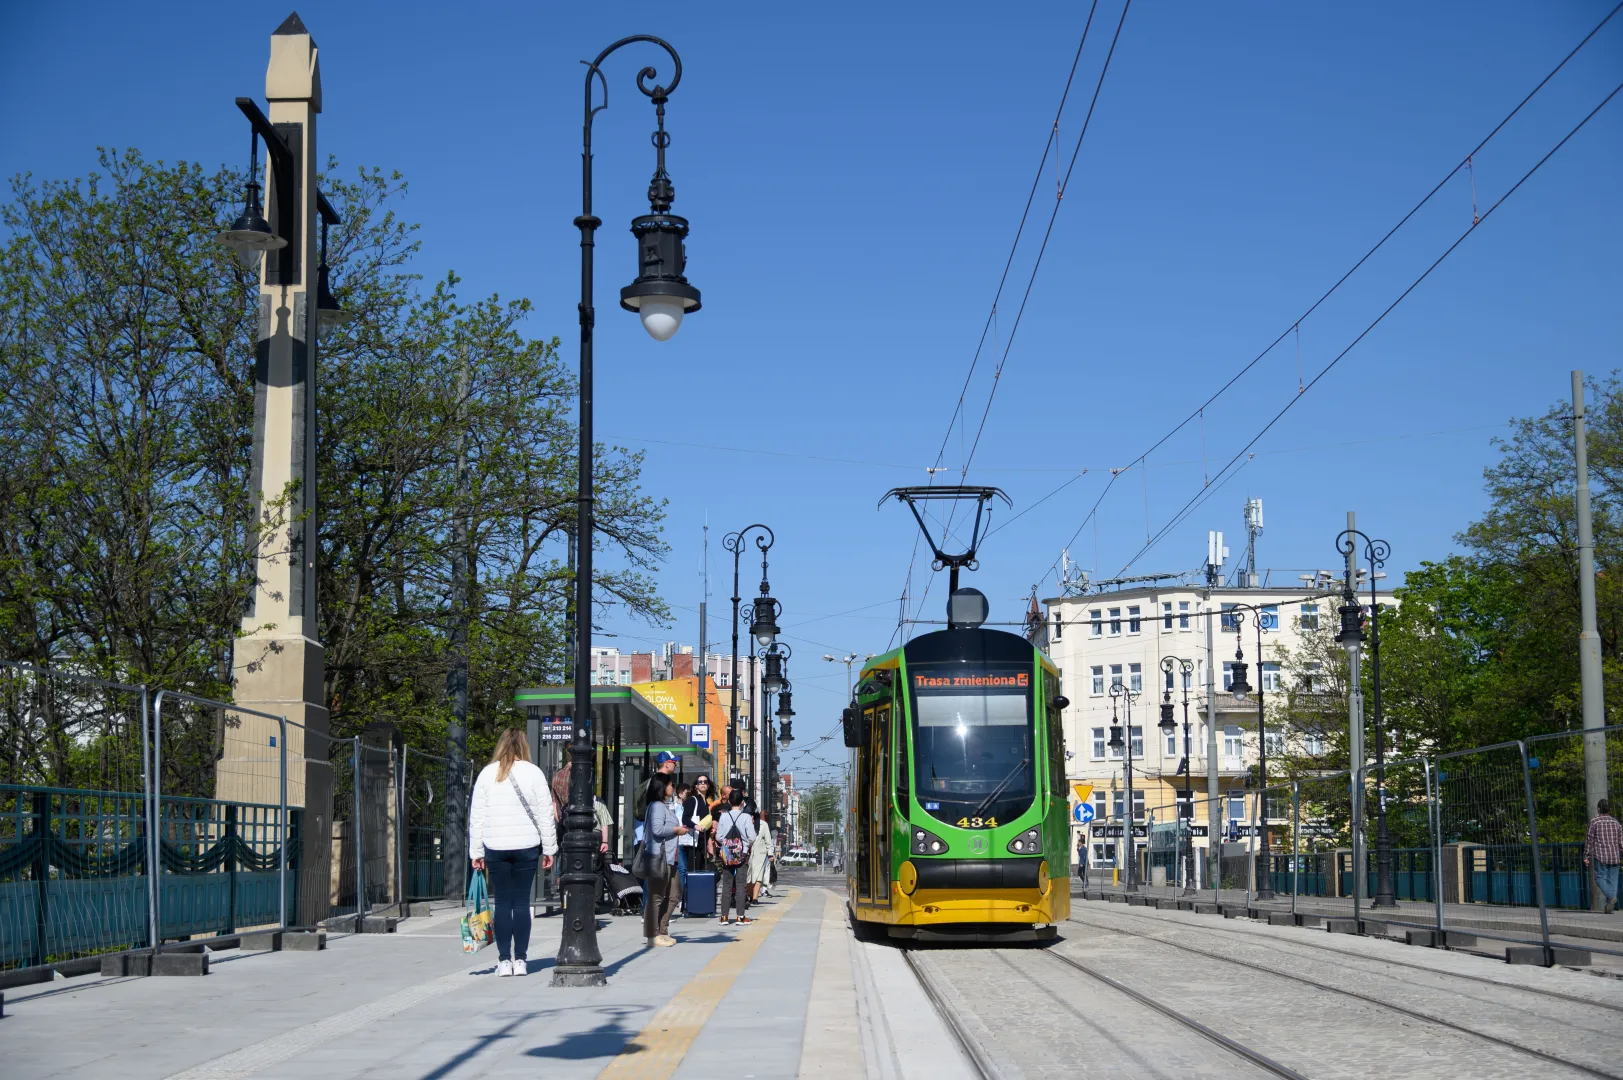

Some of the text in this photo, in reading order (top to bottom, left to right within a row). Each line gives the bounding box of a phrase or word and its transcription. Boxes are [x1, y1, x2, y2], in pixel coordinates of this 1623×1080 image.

[916, 674, 1016, 686] Trasa zmieniona
[643, 695, 675, 703] ÓLOWA
[956, 816, 998, 828] 434
